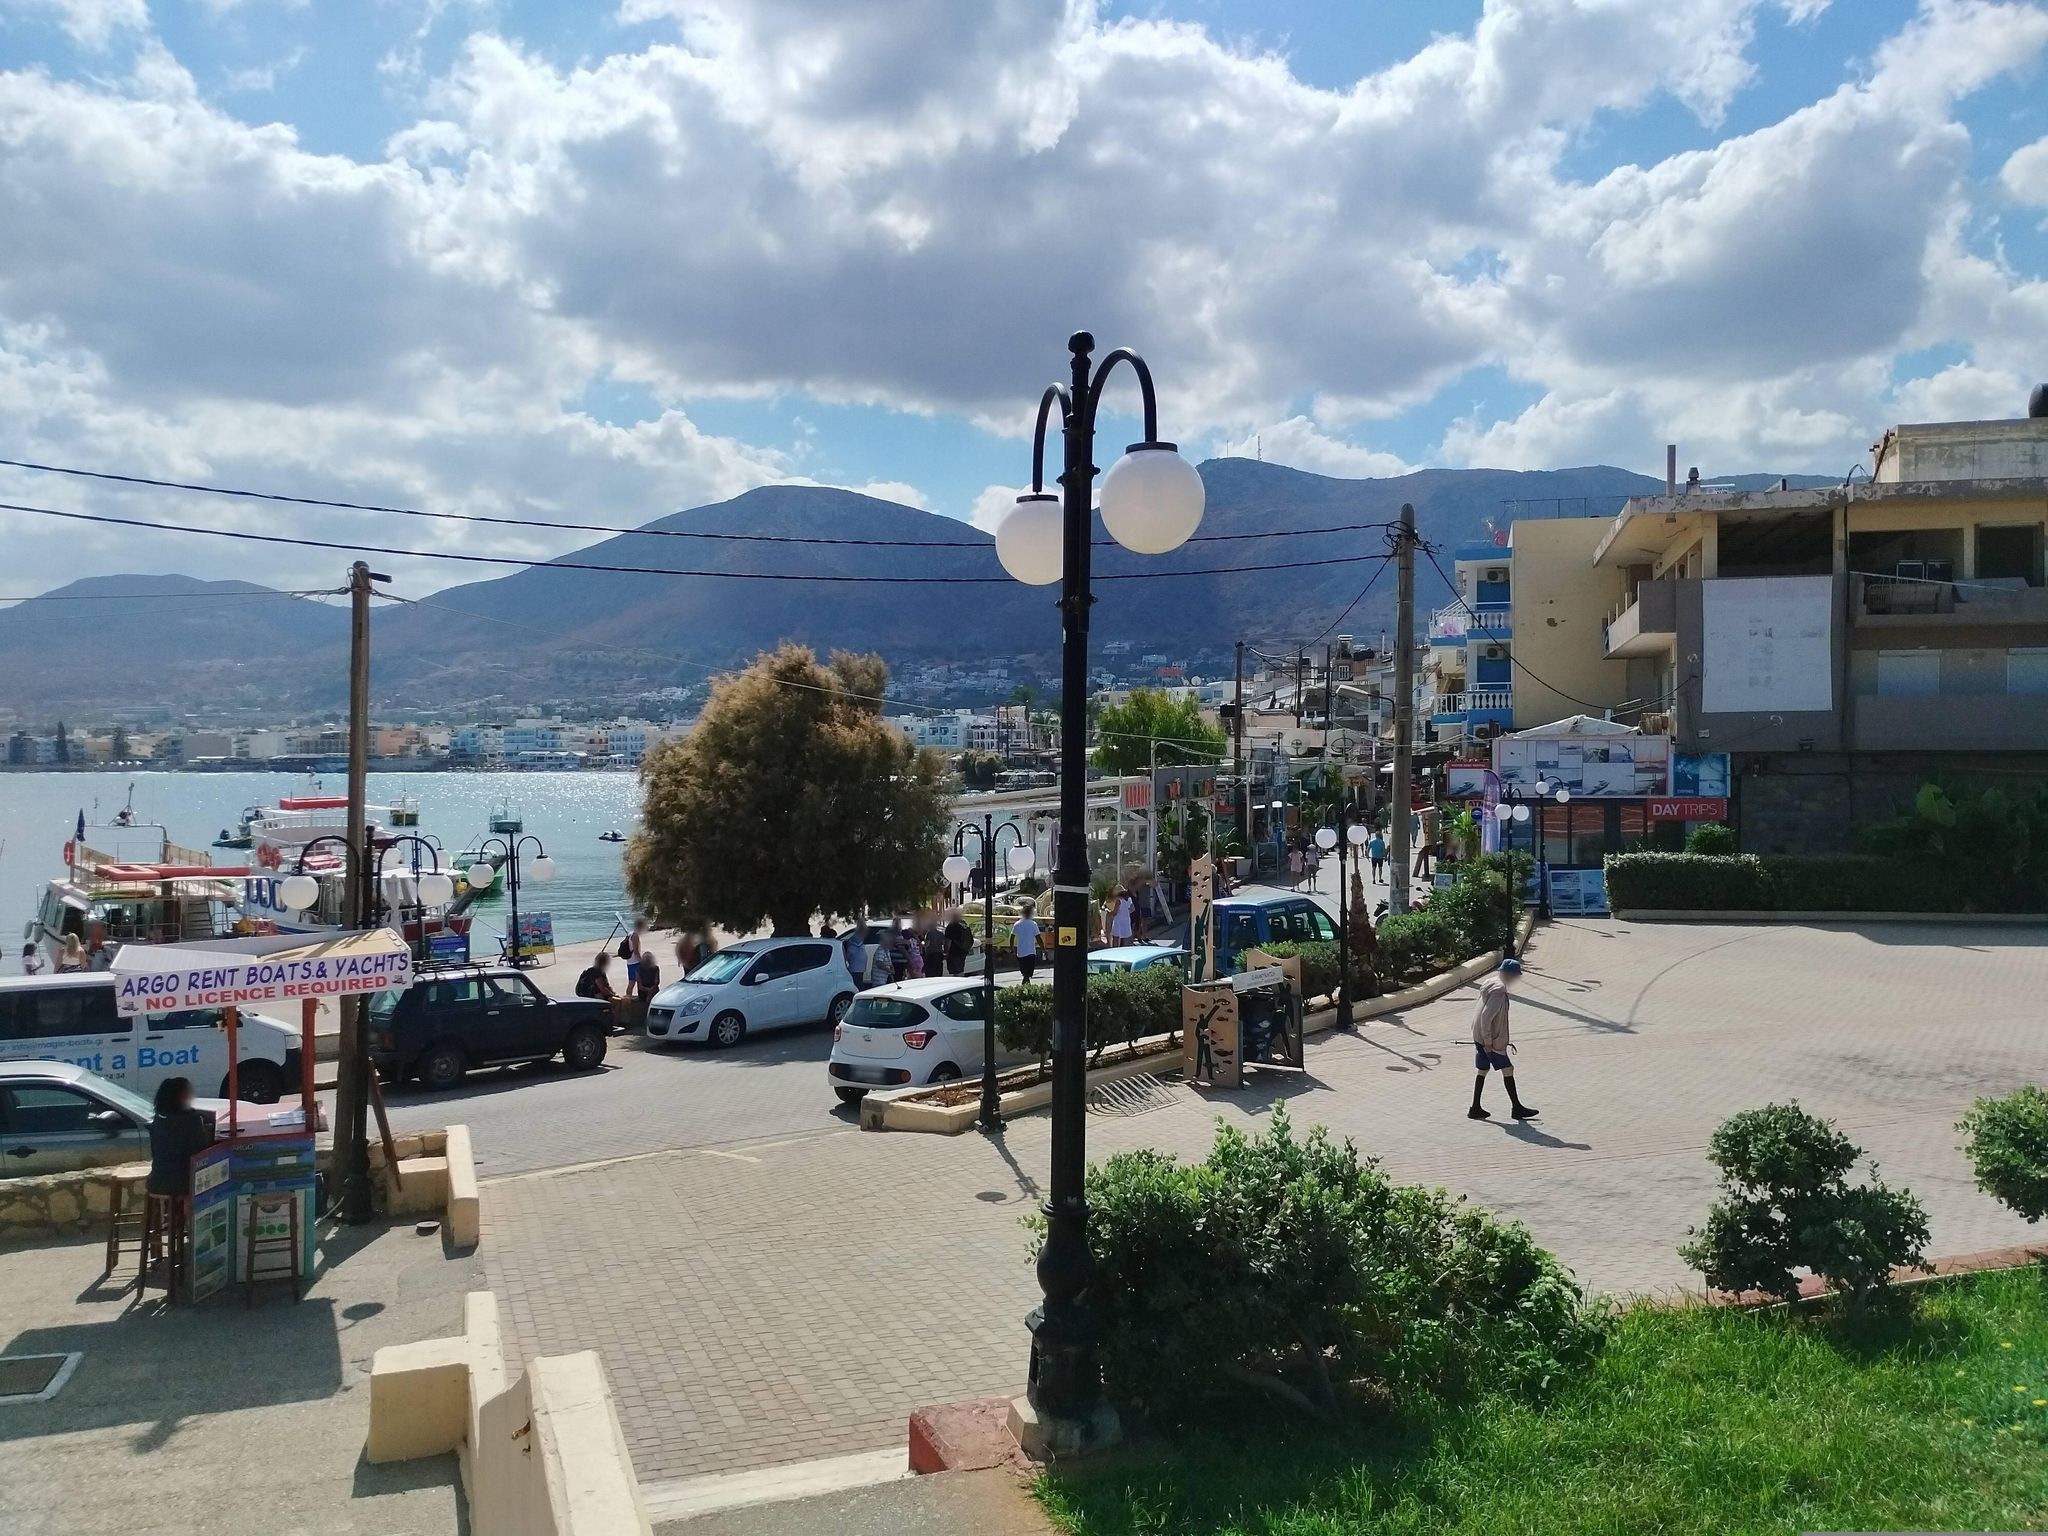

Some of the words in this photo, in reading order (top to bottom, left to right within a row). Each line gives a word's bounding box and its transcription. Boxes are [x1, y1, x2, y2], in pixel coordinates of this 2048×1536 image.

[1652, 803, 1680, 816] DAY
[1681, 803, 1718, 816] TRIPS
[121, 973, 180, 997] ARGO
[187, 967, 240, 991] RENT
[335, 952, 409, 978] YACHTS
[145, 996, 177, 1010] NO
[184, 986, 276, 1007] LICENCE
[283, 975, 388, 997] REQUIRED
[111, 1054, 126, 1070] a
[137, 1045, 199, 1068] Boat
